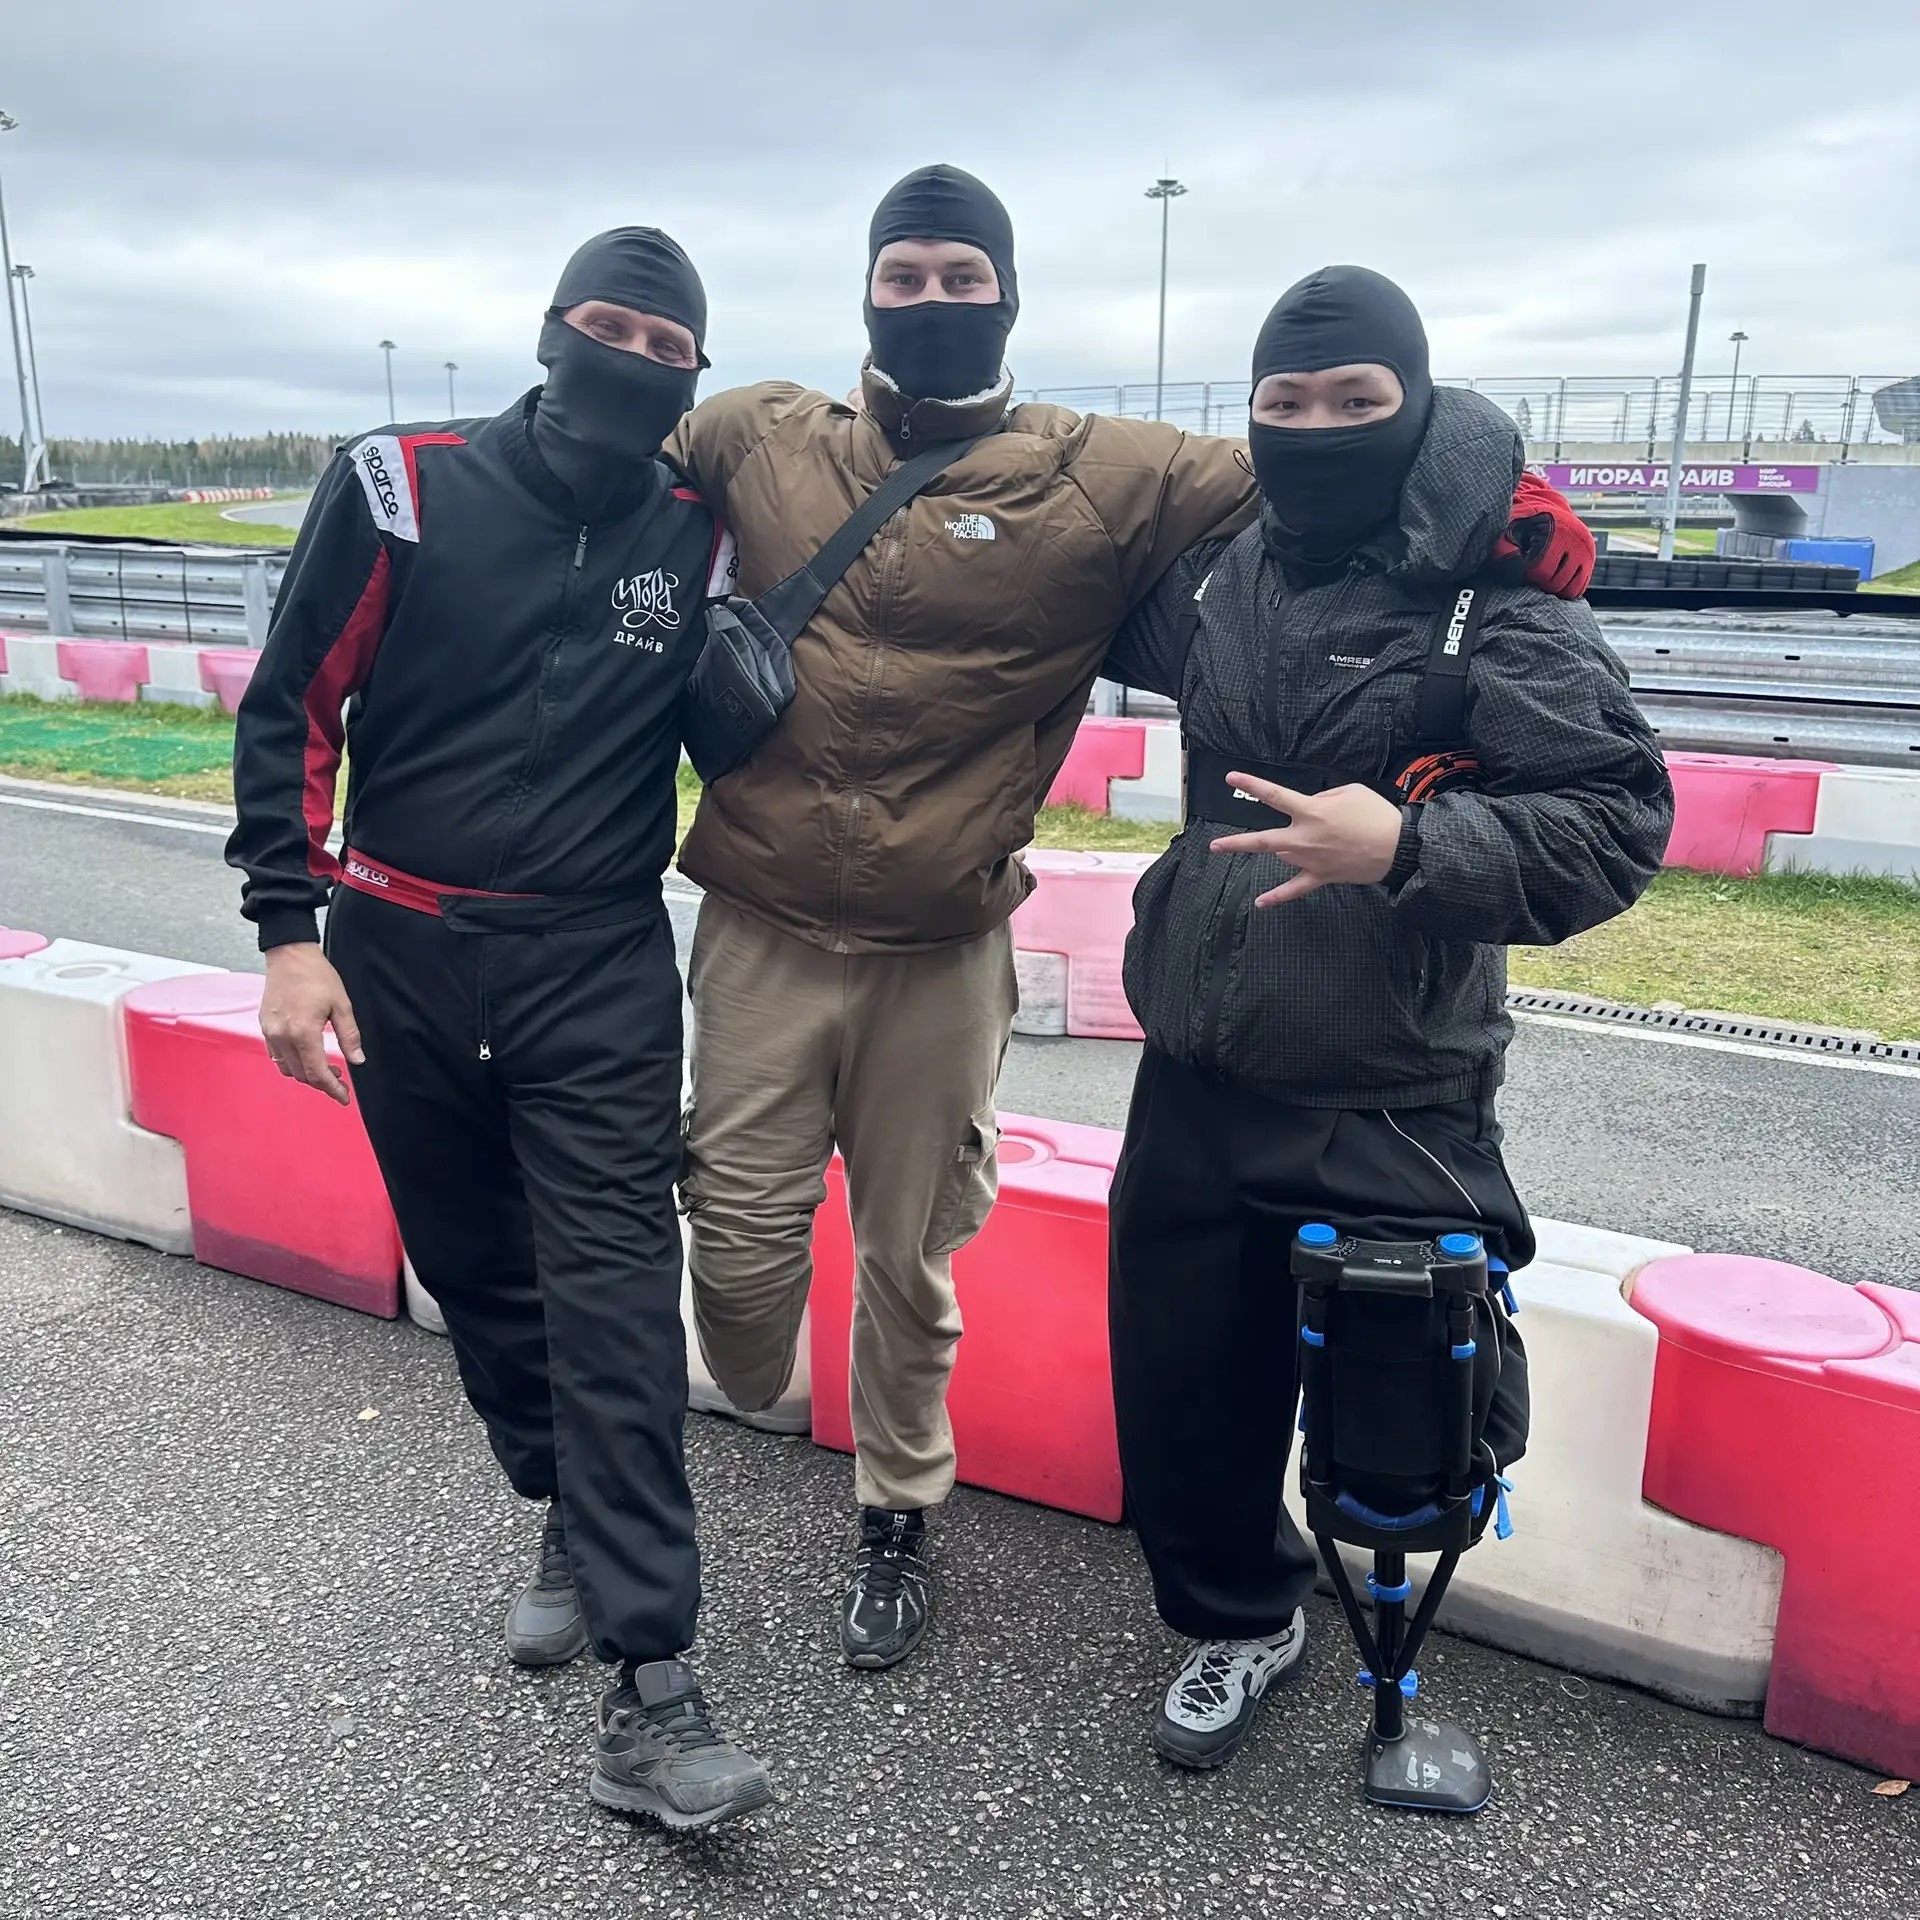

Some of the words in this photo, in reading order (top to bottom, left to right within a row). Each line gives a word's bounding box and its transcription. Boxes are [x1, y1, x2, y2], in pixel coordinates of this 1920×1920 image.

[363, 446, 399, 519] sparco
[1569, 468, 1646, 486] ИГОРА
[944, 521, 978, 531] NORTH
[959, 514, 979, 523] THE
[953, 529, 978, 539] FACE
[1443, 588, 1475, 656] BENGIO
[613, 630, 664, 653] ДРАЙВ
